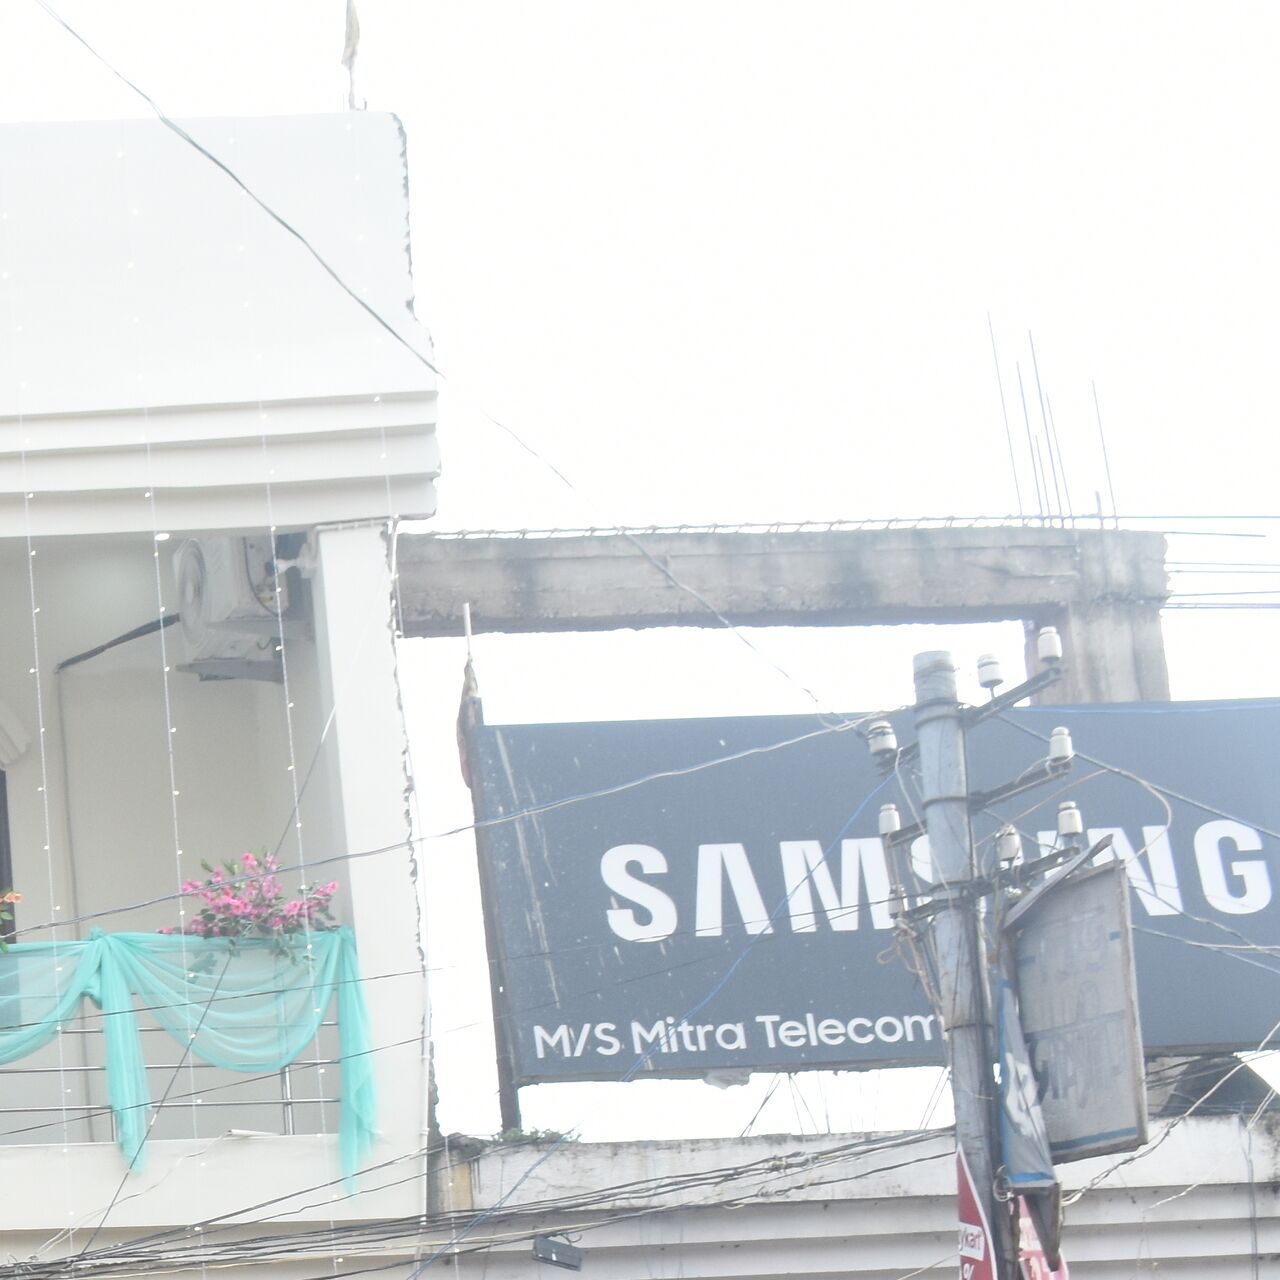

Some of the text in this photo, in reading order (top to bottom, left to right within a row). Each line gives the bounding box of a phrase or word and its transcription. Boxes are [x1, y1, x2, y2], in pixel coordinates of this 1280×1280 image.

[600, 820, 1272, 942] SAMNG
[533, 1022, 621, 1058] M/S
[630, 1017, 746, 1055] Mitra
